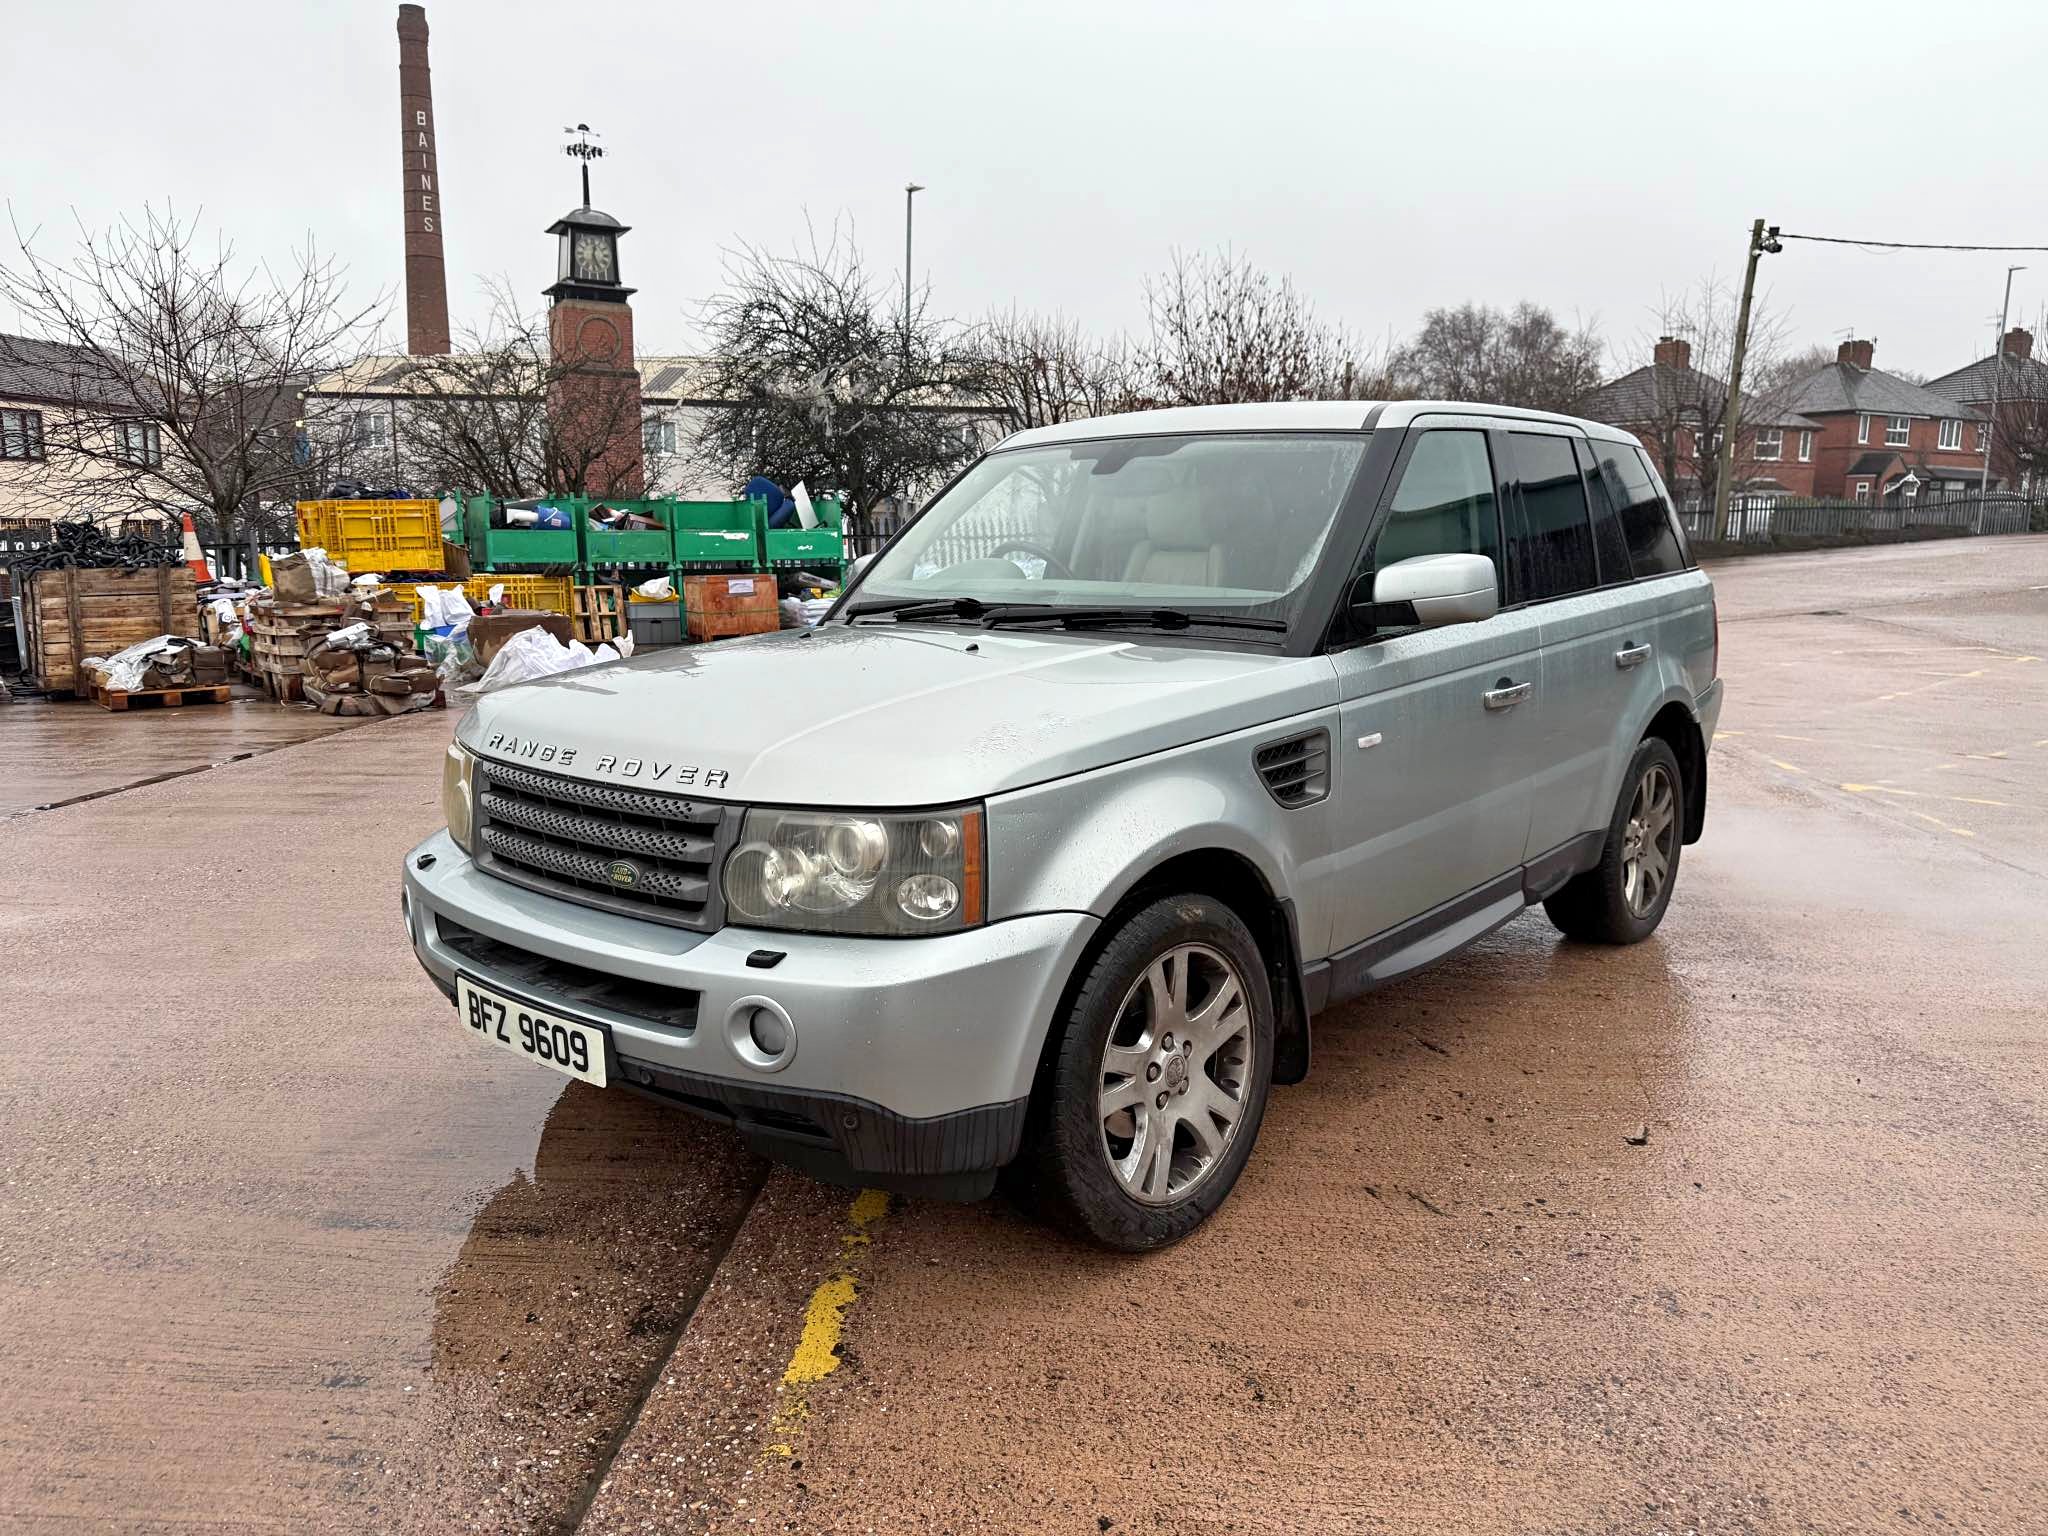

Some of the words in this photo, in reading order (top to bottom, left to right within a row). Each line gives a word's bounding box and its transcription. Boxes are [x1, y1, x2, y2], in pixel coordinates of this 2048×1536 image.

[416, 111, 434, 232] BAINES
[489, 732, 577, 765] RANGE
[596, 755, 729, 788] ROVER
[613, 873, 632, 883] ROVER
[467, 990, 511, 1044] BFZ
[518, 1012, 589, 1073] 9609
